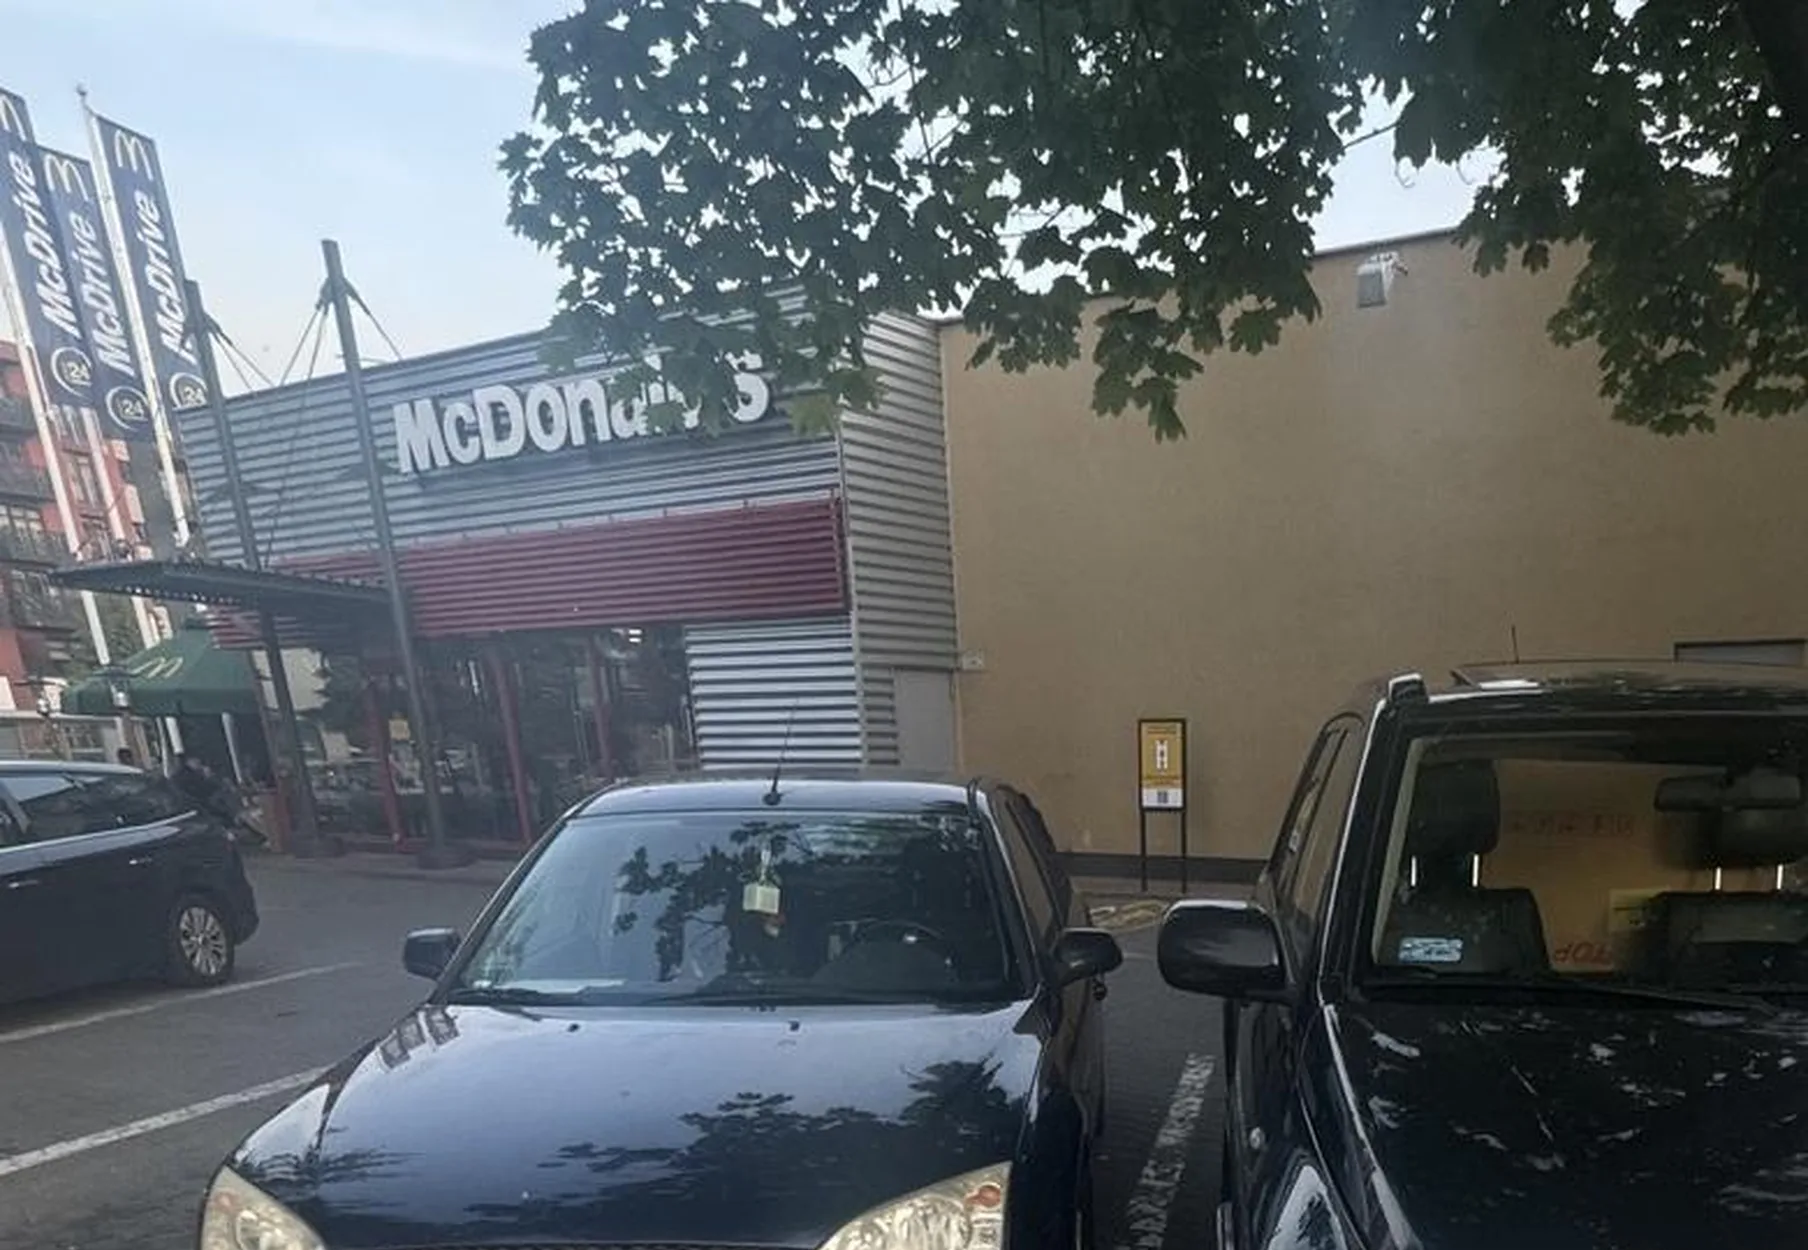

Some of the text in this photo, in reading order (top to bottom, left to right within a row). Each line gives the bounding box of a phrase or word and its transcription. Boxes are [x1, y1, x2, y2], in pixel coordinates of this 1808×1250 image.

[9, 151, 82, 340] McDrive
[69, 211, 136, 377] McDrive
[134, 190, 198, 366] McDrive
[393, 349, 770, 474] McDonas
